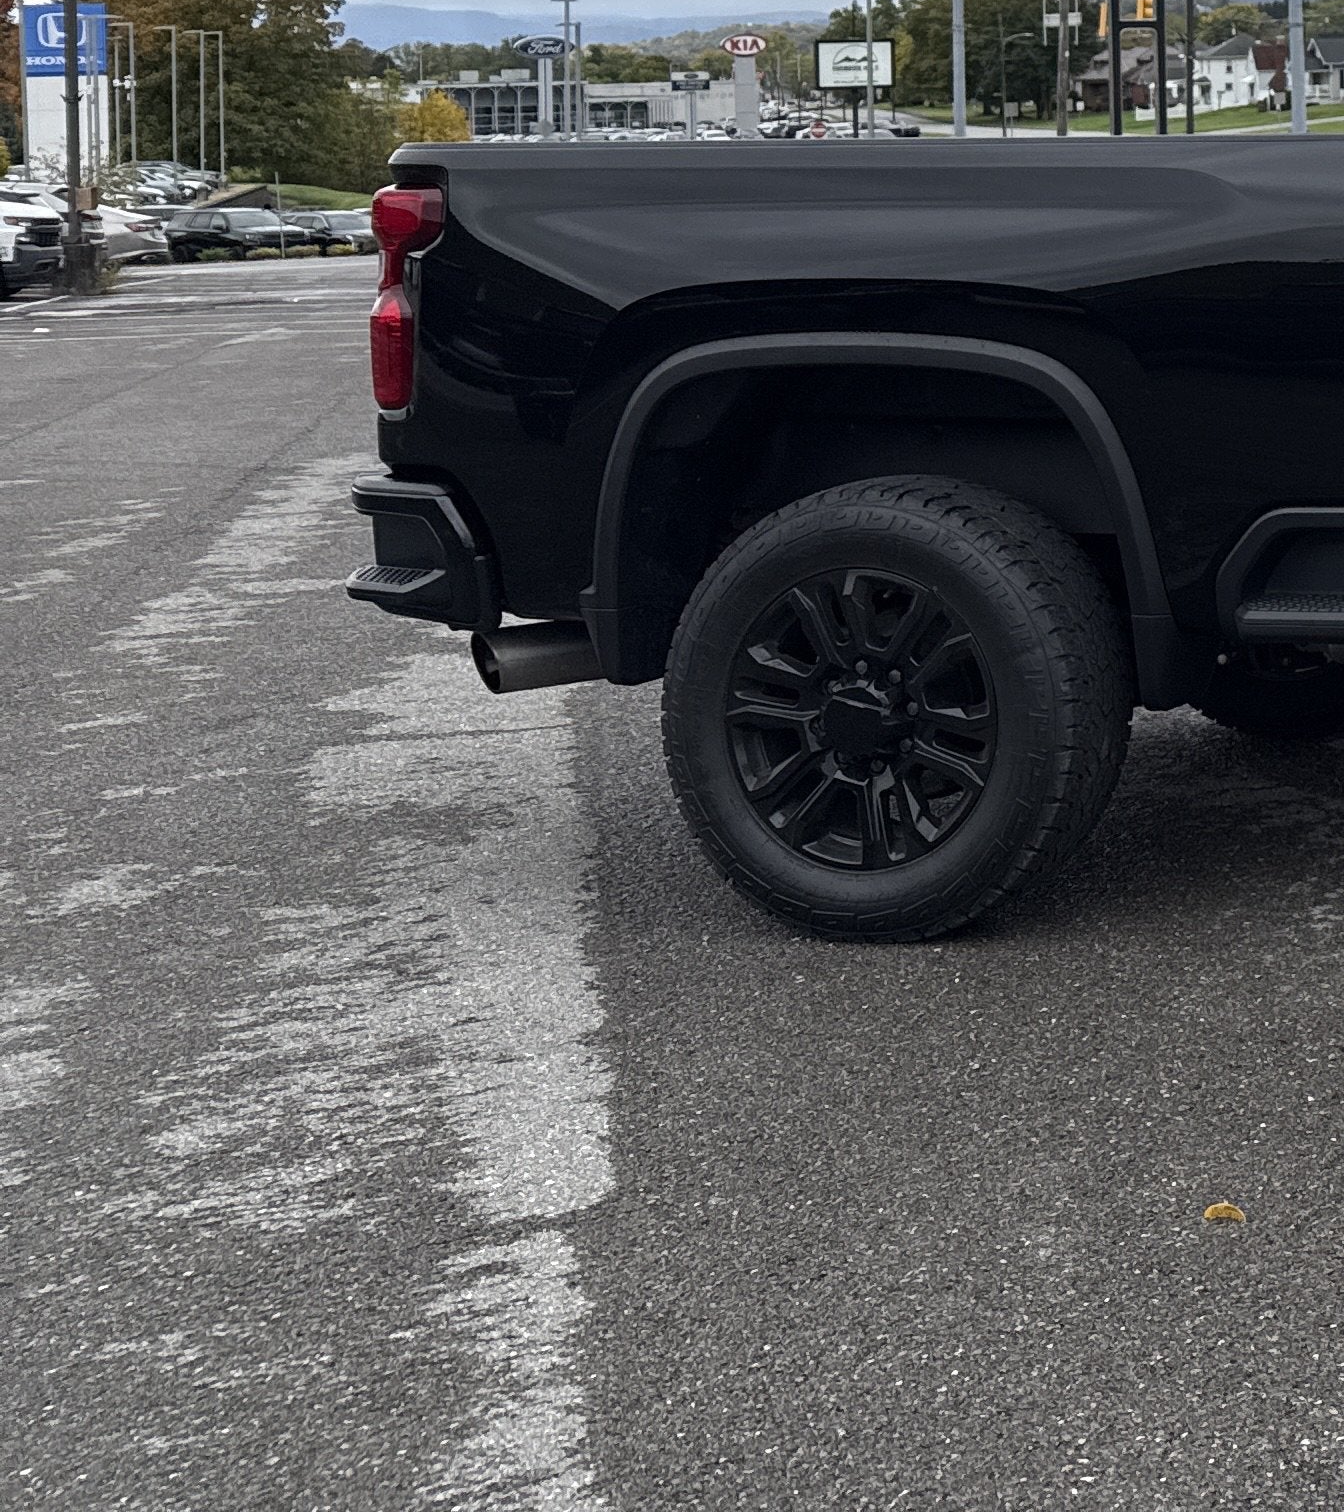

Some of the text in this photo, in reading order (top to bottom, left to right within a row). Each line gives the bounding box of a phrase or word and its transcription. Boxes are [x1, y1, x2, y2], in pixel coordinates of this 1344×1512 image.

[527, 39, 563, 55] Ford
[730, 38, 760, 51] KIA
[26, 55, 103, 65] HOND
